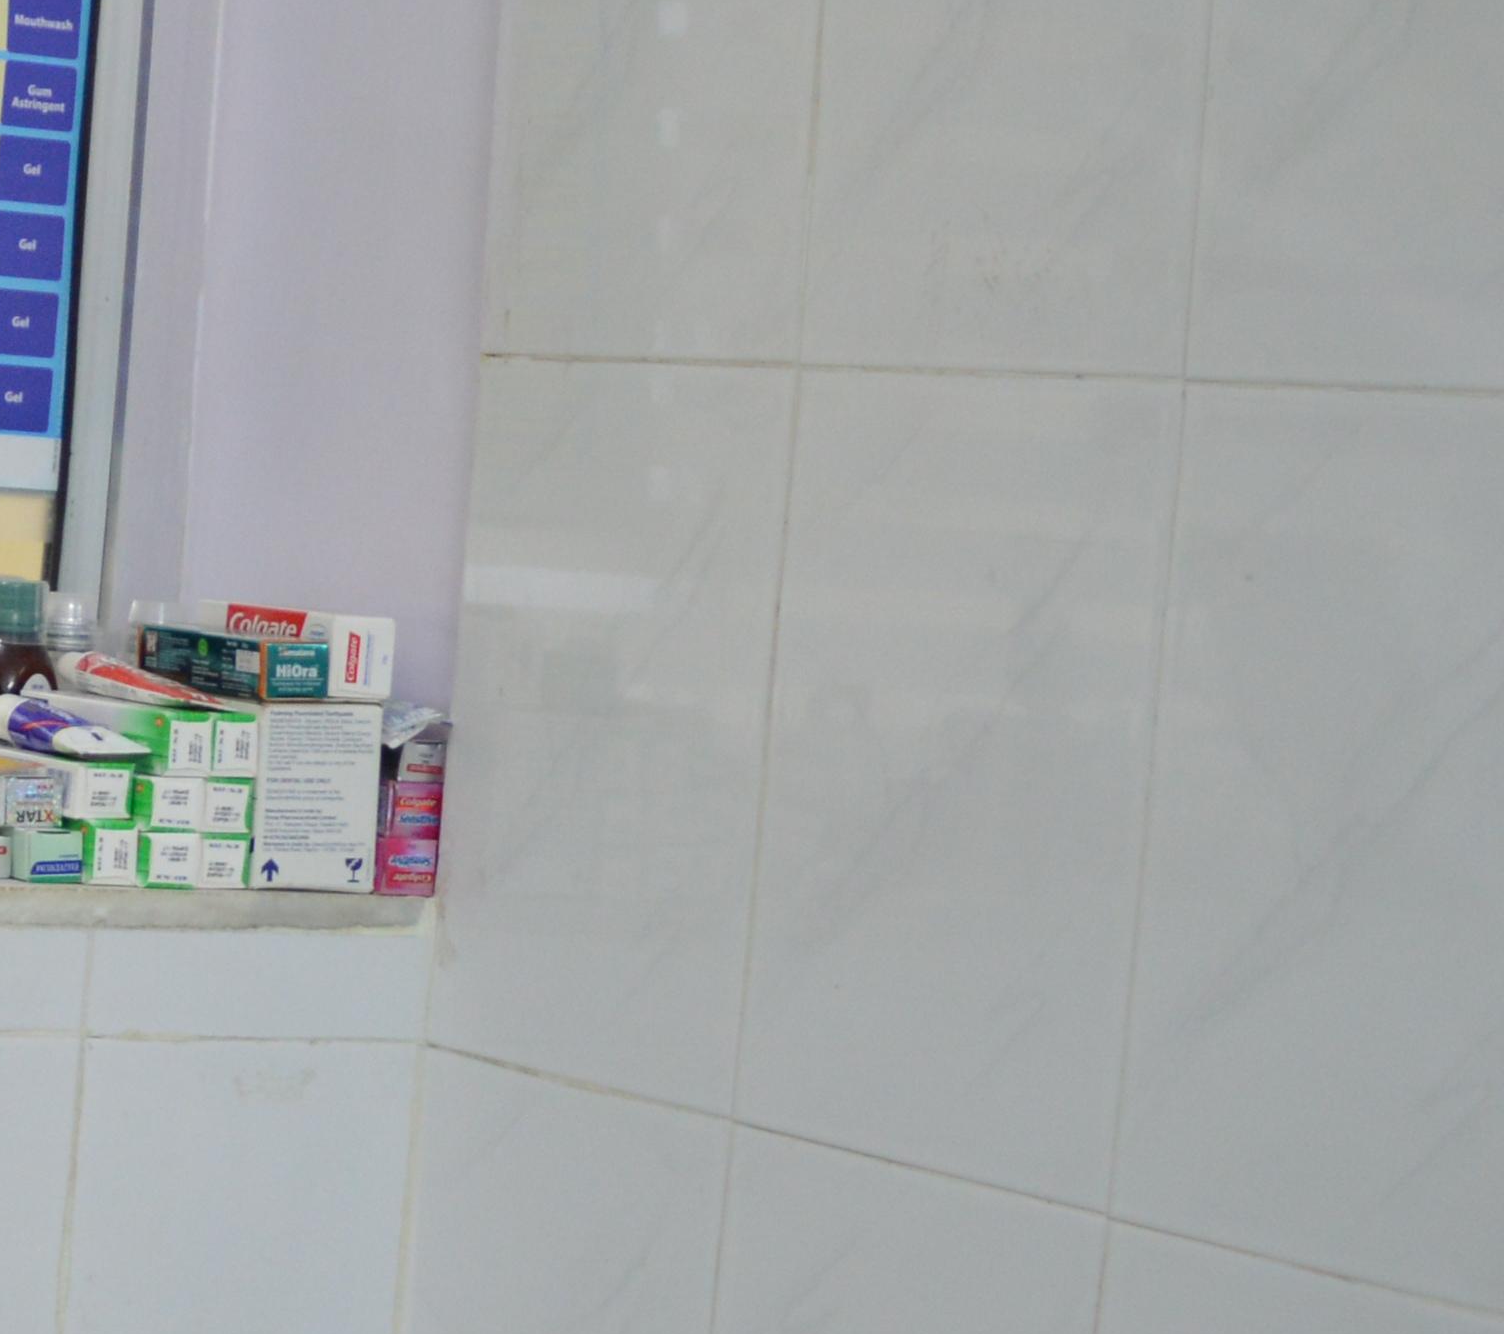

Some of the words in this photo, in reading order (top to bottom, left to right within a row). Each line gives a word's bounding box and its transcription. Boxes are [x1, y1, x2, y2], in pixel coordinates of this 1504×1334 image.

[14, 14, 74, 31] Mouthwash
[27, 84, 52, 98] Gum
[11, 96, 65, 113] Astringent
[23, 163, 41, 176] Gel
[19, 238, 37, 251] Gel
[11, 315, 30, 329] Gel
[4, 390, 23, 403] Gel
[228, 611, 298, 636] Colgate
[276, 663, 319, 678] HiOra
[16, 810, 56, 824] XTAR
